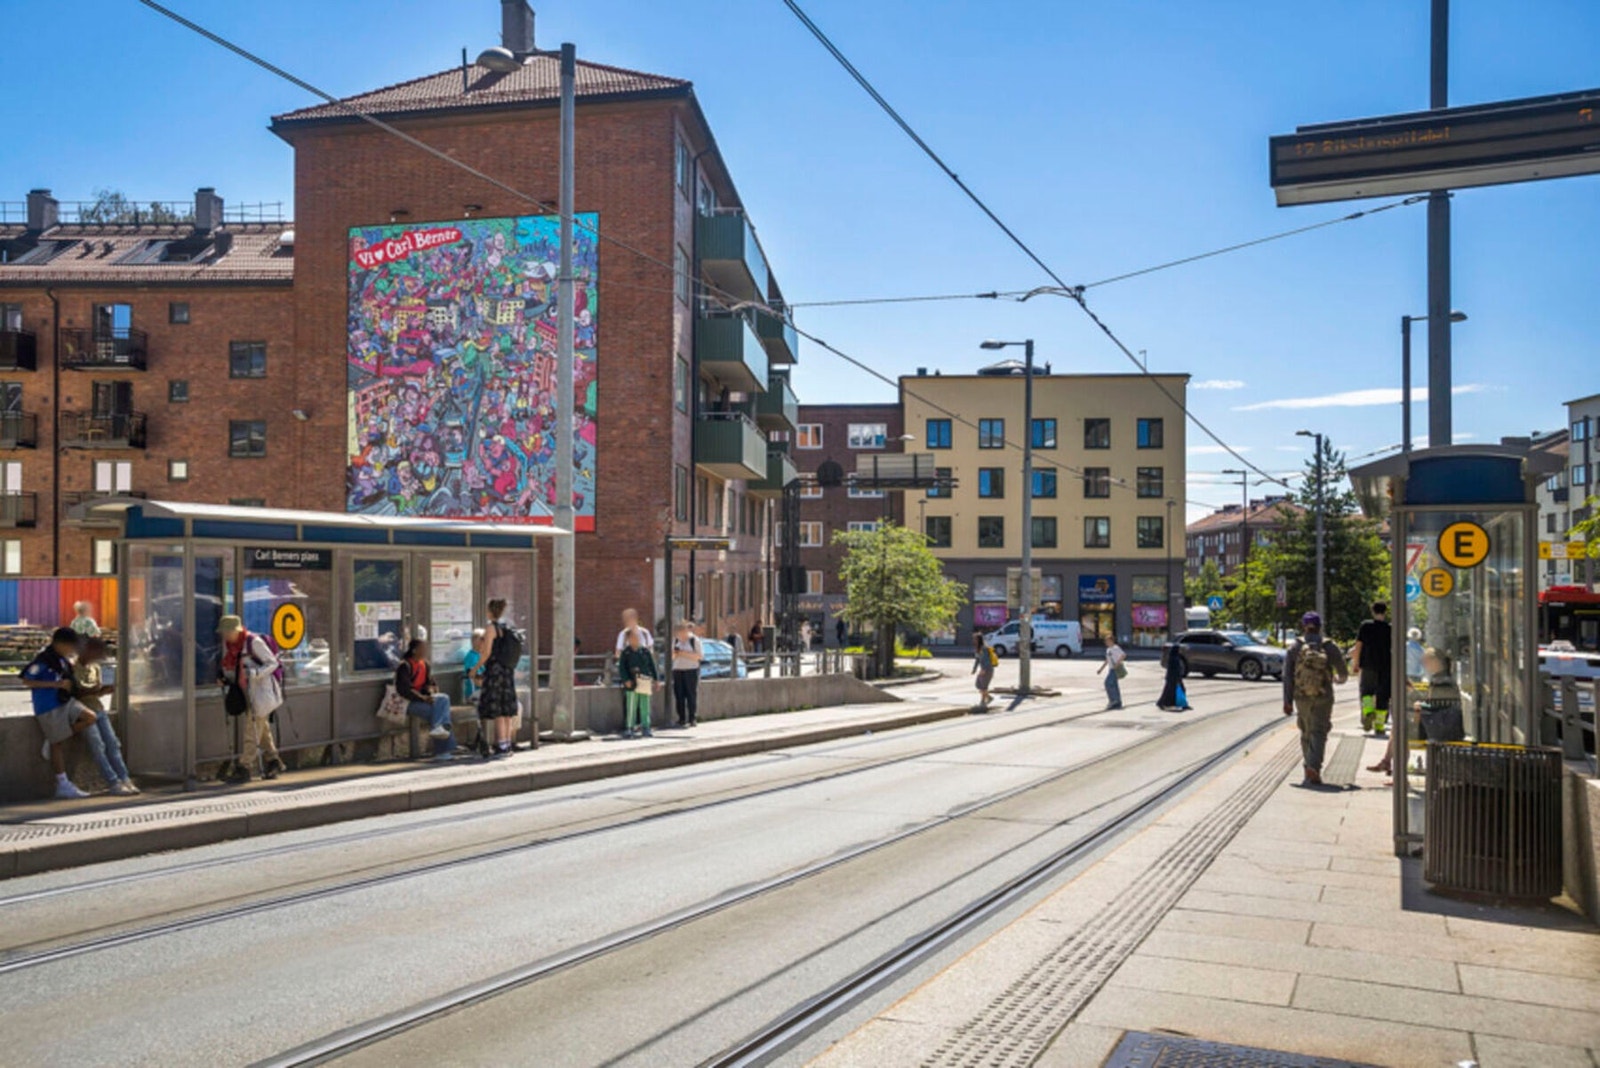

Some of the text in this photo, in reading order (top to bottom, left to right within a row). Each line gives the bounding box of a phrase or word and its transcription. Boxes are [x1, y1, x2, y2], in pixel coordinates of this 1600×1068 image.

[386, 235, 413, 259] Carl
[414, 230, 457, 249] Berner
[255, 549, 271, 560] Carl
[272, 550, 299, 561] Berners
[1454, 531, 1474, 558] E
[1431, 574, 1444, 591] E
[282, 612, 296, 640] C
